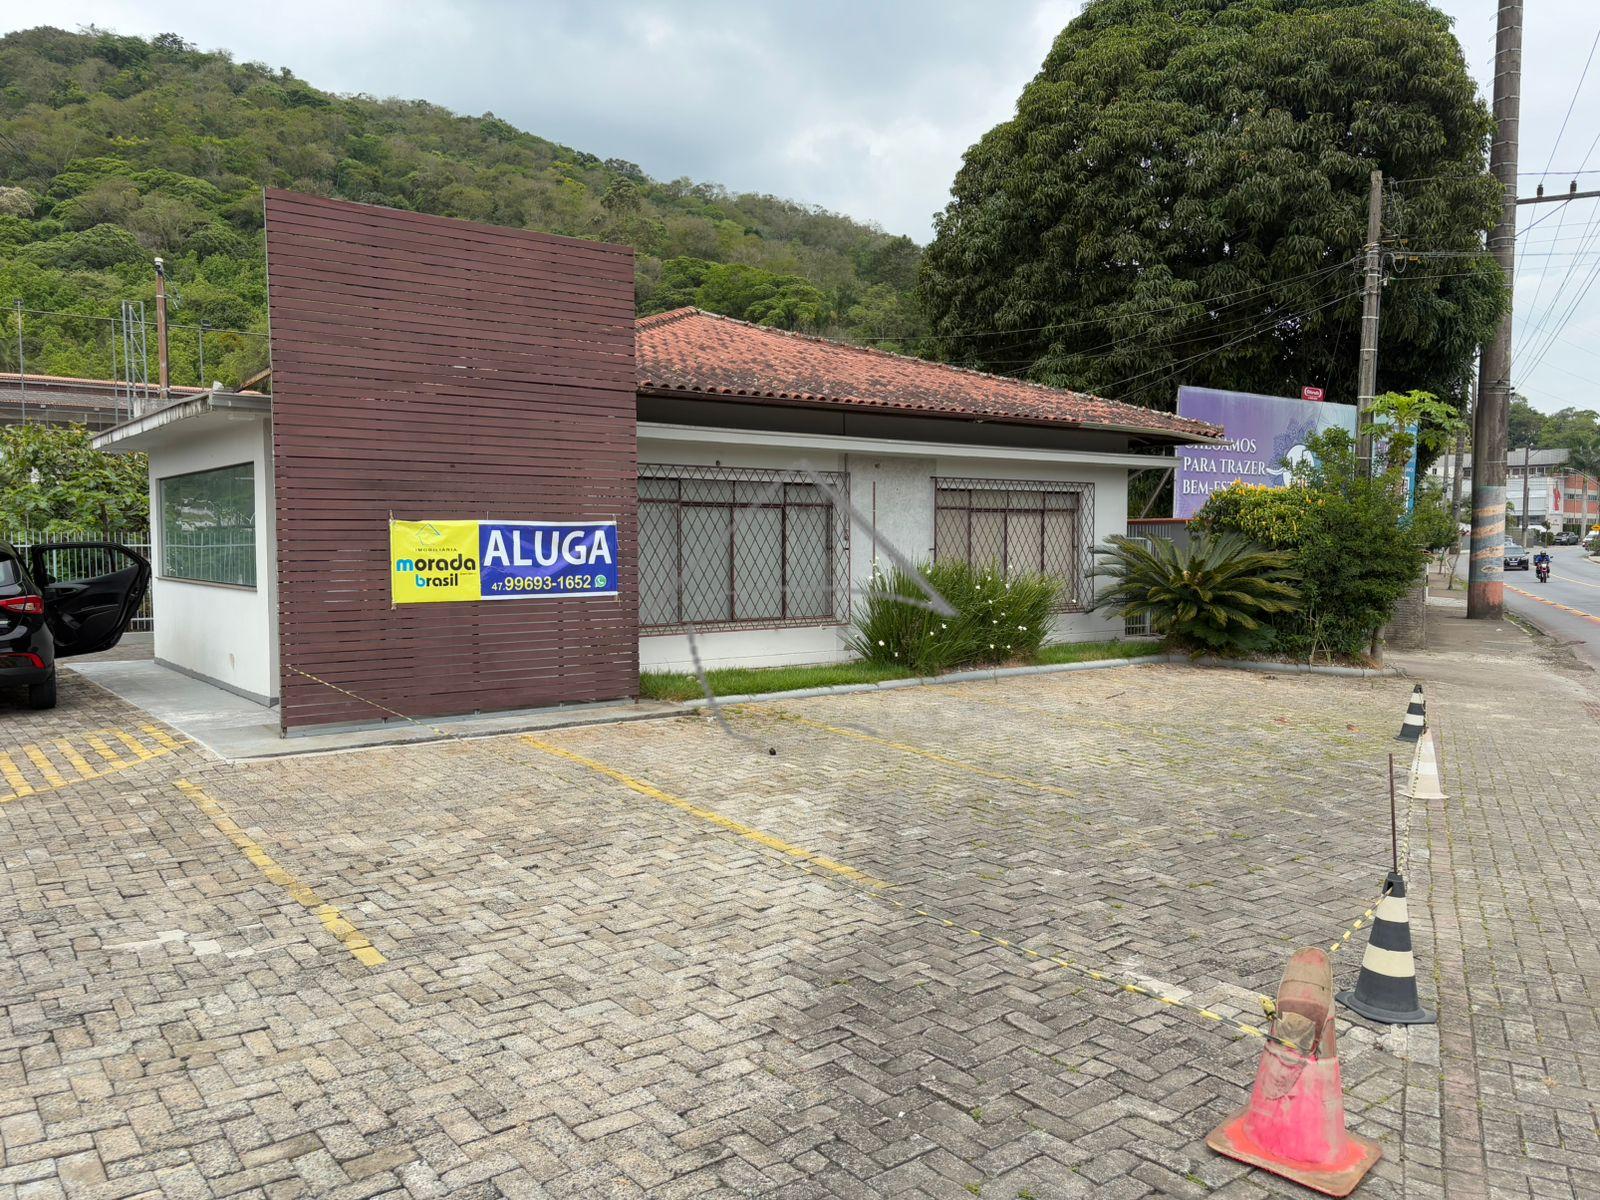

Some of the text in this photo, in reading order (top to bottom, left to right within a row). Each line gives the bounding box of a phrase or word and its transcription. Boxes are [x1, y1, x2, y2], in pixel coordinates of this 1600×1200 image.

[1183, 456, 1266, 475] PARA TRAZER
[483, 529, 612, 567] ALUGA
[396, 553, 476, 572] morada
[415, 573, 458, 588] brasil
[491, 574, 591, 591] 47.99693-1652
